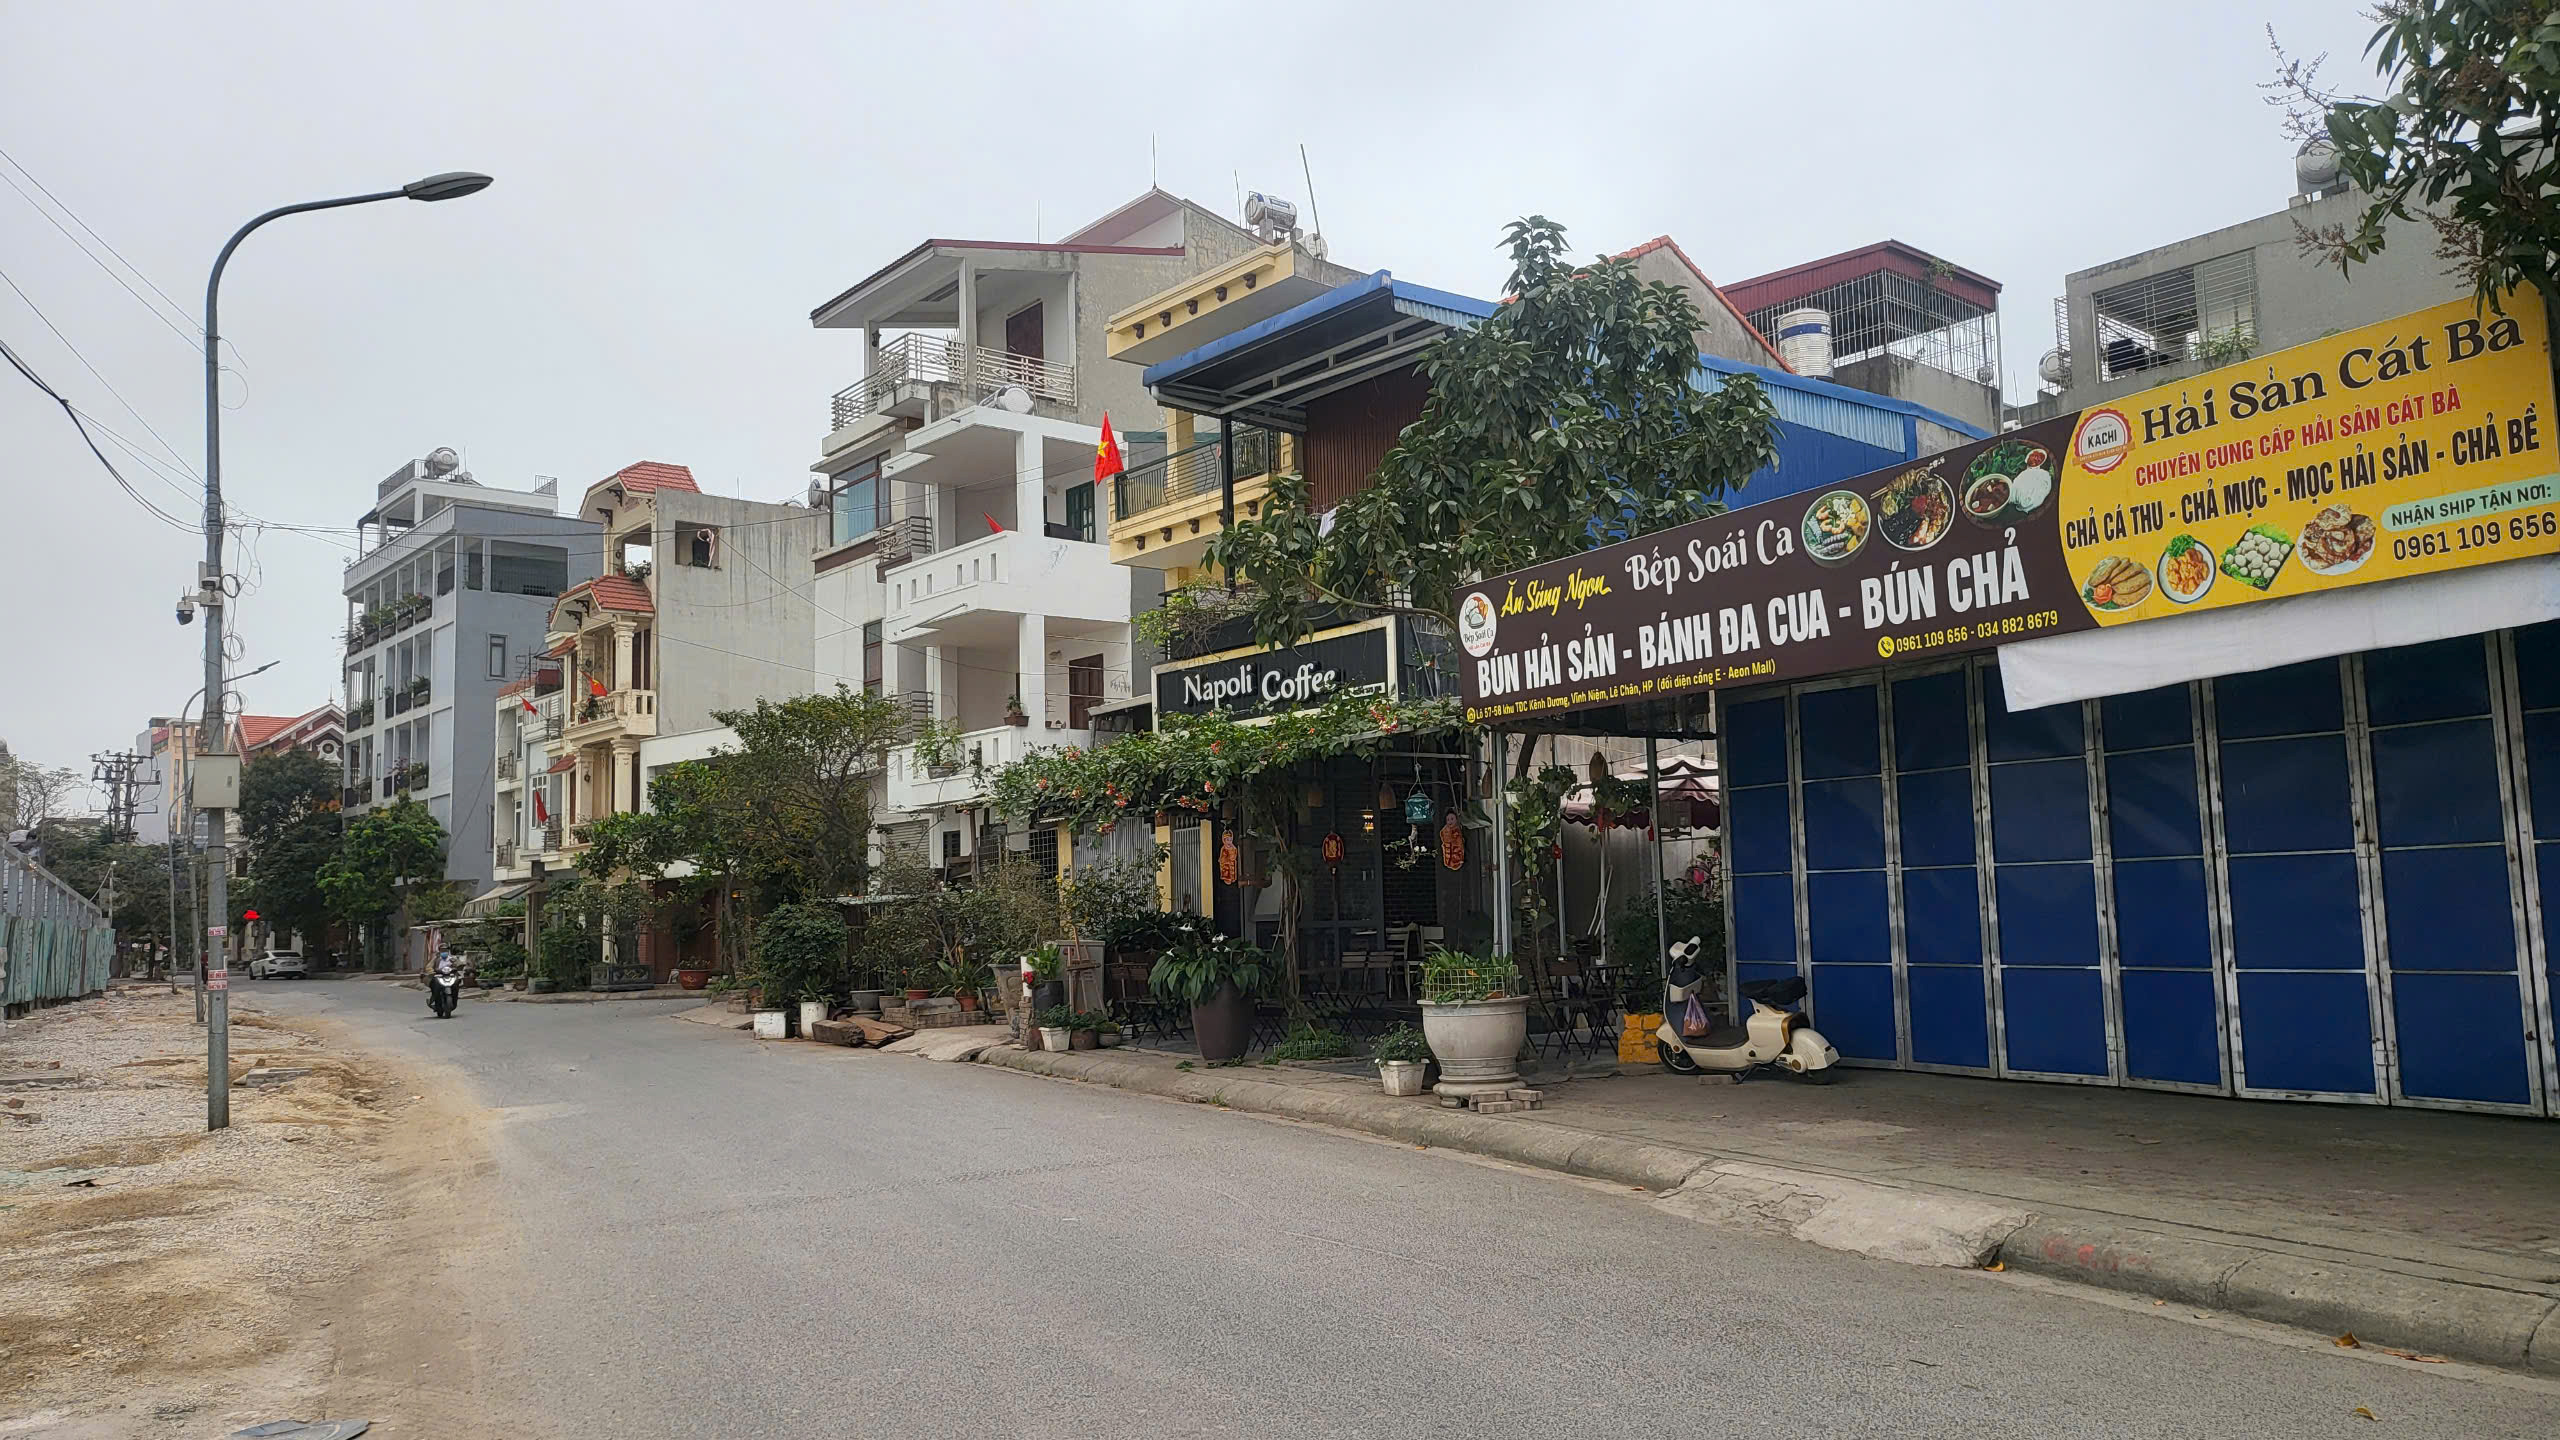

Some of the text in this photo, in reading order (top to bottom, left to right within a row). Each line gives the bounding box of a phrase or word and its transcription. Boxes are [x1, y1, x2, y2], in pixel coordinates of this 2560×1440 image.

[2140, 388, 2218, 444] Hải
[2228, 365, 2327, 420] Sản
[2338, 335, 2431, 389] Cát
[2087, 429, 2117, 448] KACHI
[2135, 451, 2201, 487] CHUYÊN
[2206, 440, 2254, 470] CUNG
[2259, 424, 2295, 457] CẤP
[2302, 413, 2333, 447] HẢI
[2339, 404, 2381, 437] SẢN
[2387, 394, 2425, 426] CÁT
[2431, 383, 2462, 416] BÀ
[2066, 506, 2099, 549] CHẢ
[2103, 504, 2127, 541] CÁ
[2130, 501, 2164, 535] THU
[2181, 478, 2219, 524] CHẢ
[2223, 476, 2267, 518] MỰC
[2287, 462, 2333, 504] MỌC
[2340, 443, 2376, 490] HẢI
[2382, 432, 2430, 480] SẢN
[2436, 451, 2445, 460] -
[2452, 411, 2501, 465] CHẢ
[2507, 402, 2540, 455] BỀ
[2392, 484, 2552, 527] NHẬN SHIP TẬN NƠI:
[1625, 519, 1795, 595] Bếp Soái Ca
[2393, 511, 2557, 560] 0961 109 656
[1477, 527, 2030, 698] BÚN HẢI SẢN - BÁNH ĐA CUA - BÚN CHẢ
[1500, 568, 1612, 617] Ăn Sáng Ngon
[1896, 635, 1922, 653] 0961
[1924, 631, 1944, 647] 109
[1947, 626, 1968, 644] 656
[1977, 621, 1999, 638] 034
[2002, 616, 2024, 634] 882
[2027, 610, 2058, 630] 8679
[1183, 662, 1337, 708] Napoli Coffee
[1484, 705, 1502, 718] 57-58
[1503, 704, 1515, 715] khu
[1529, 699, 1546, 711] Kênh
[1571, 691, 1587, 704] Vĩnh
[1609, 686, 1618, 698] Lê
[1620, 683, 1641, 696] Chân,
[1642, 680, 1653, 693] HP
[1657, 674, 1673, 693] (đối
[1674, 674, 1691, 689] diện
[1693, 668, 1713, 685] cổng
[1715, 668, 1721, 681] E
[1728, 665, 1750, 679] Aeon
[1752, 658, 1776, 675] Mall)
